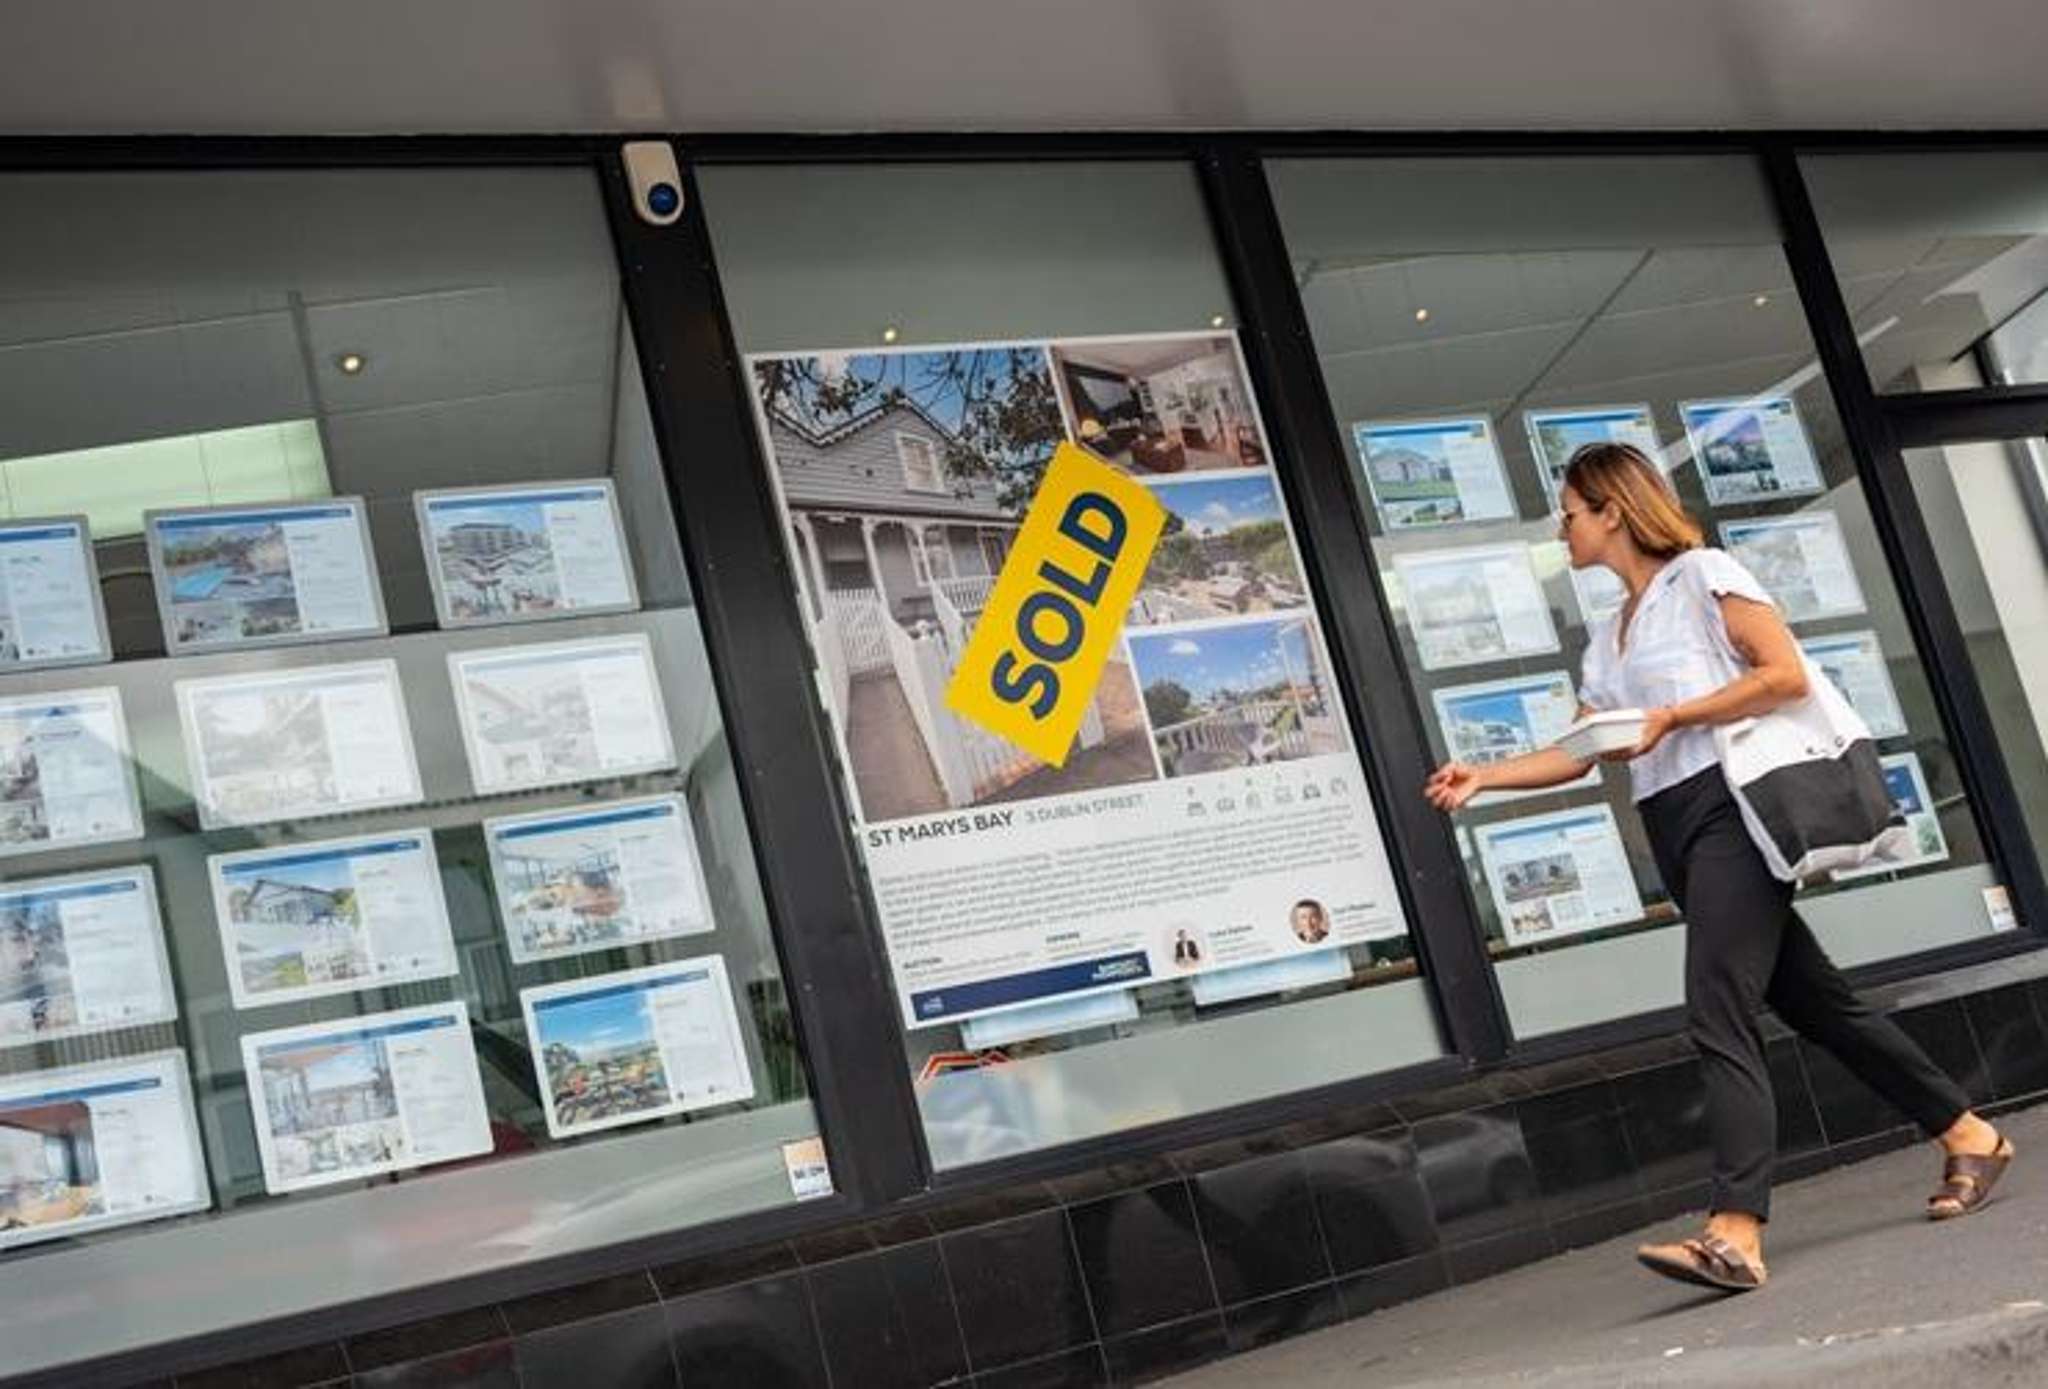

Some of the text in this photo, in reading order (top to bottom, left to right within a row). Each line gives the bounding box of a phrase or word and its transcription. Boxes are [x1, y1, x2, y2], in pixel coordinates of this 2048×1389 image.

[991, 491, 1128, 721] SOLD
[1037, 801, 1091, 822] DUBLIN
[1092, 793, 1144, 813] STREET
[868, 810, 1013, 848] ST MARYS BAY
